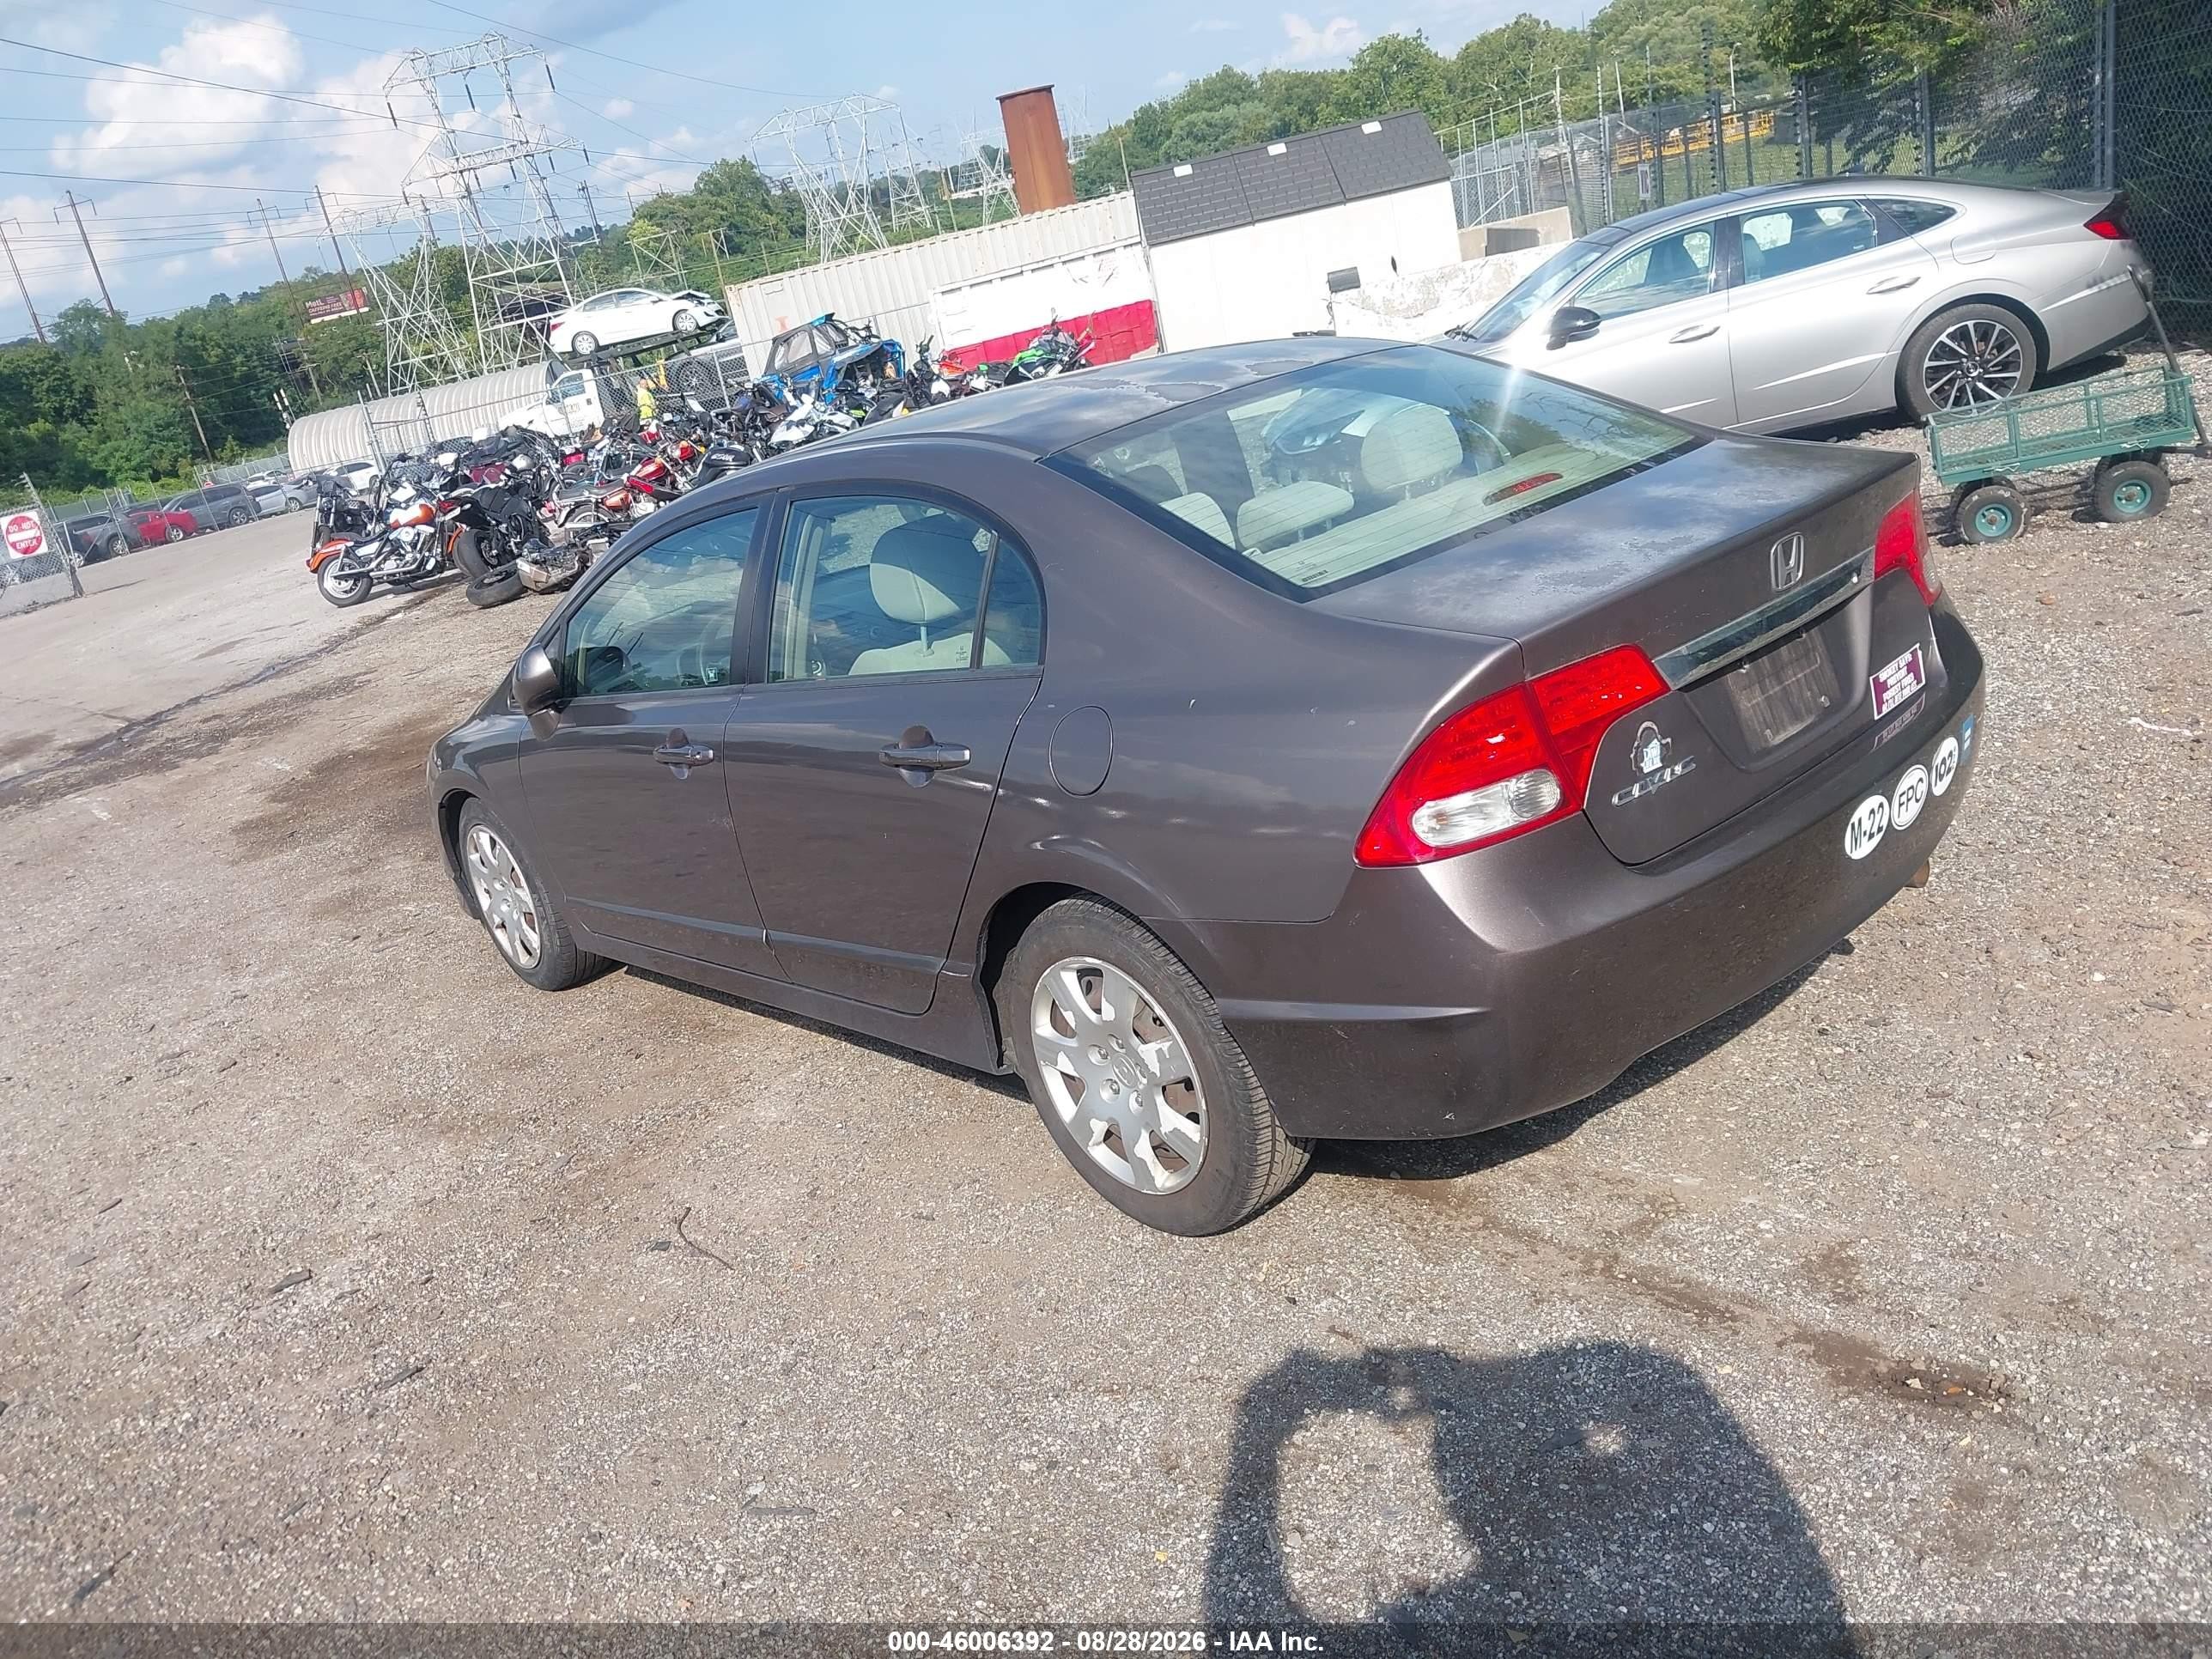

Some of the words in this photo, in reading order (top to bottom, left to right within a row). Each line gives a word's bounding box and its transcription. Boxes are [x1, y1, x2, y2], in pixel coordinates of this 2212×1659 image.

[9, 524, 18, 532] DO
[21, 520, 37, 530] NOT
[1612, 756, 1697, 807] CIVIC
[1898, 777, 1924, 818] FPC
[1850, 801, 1885, 854] M-22
